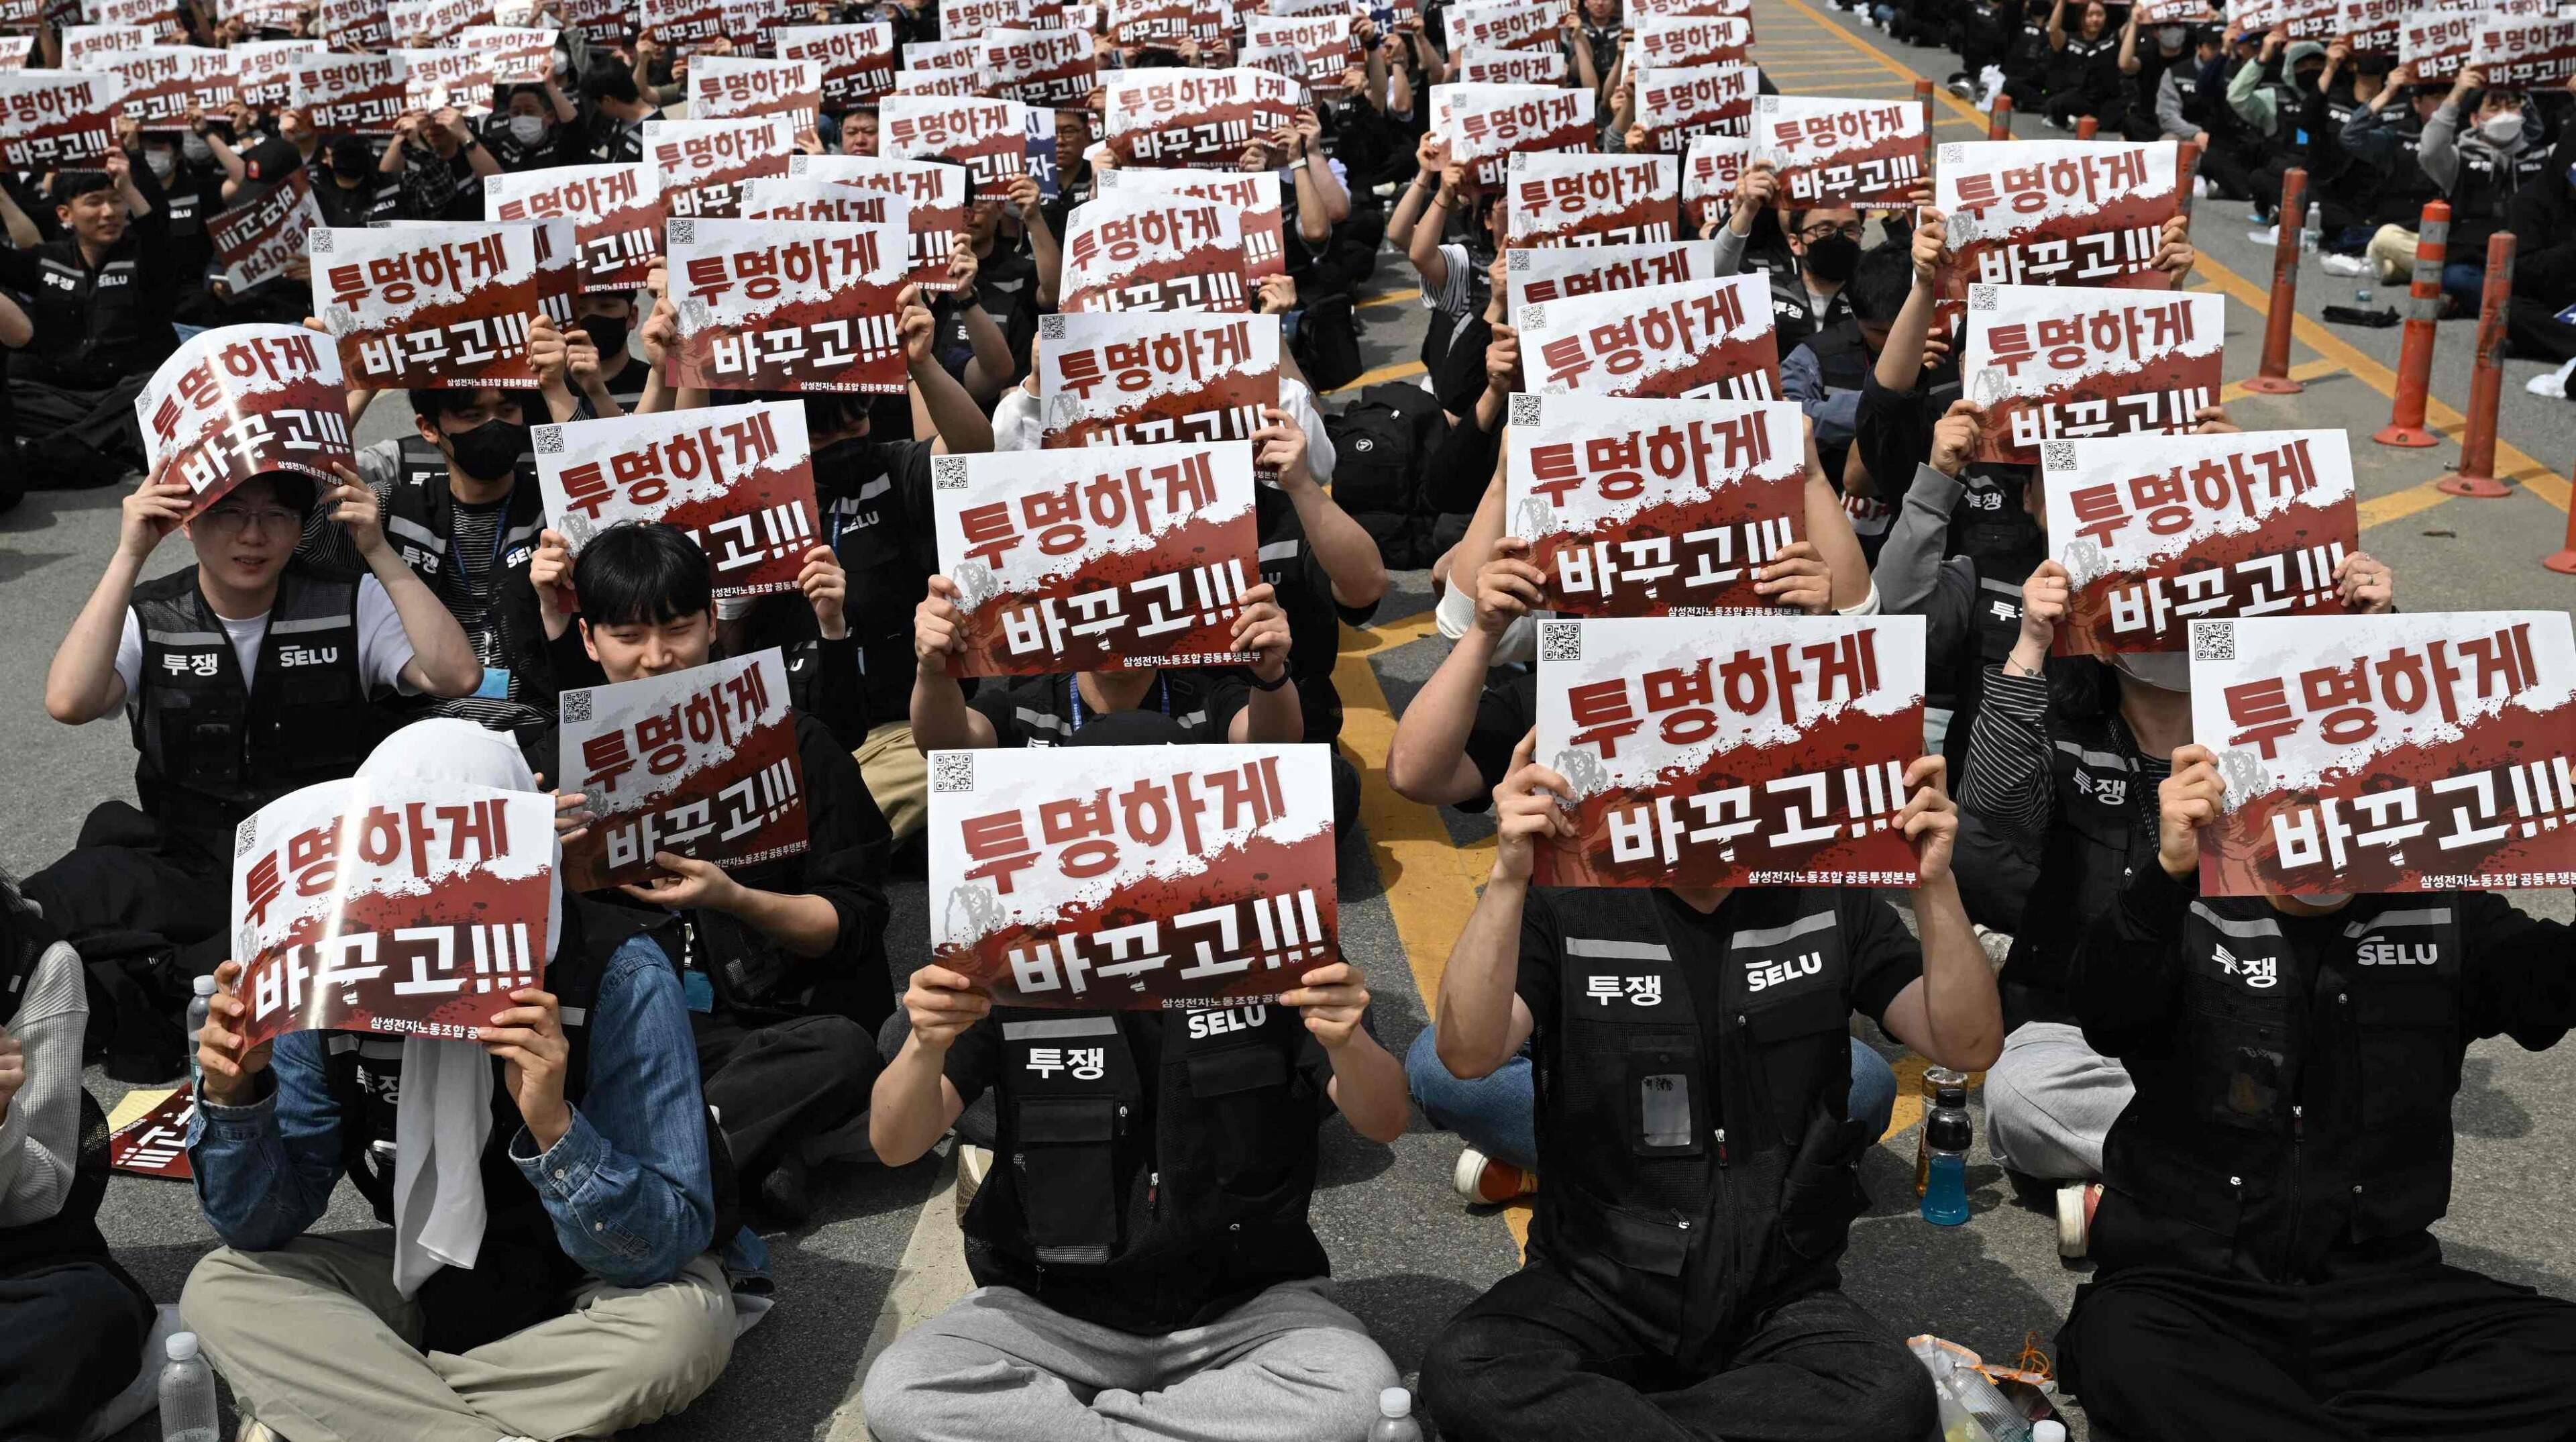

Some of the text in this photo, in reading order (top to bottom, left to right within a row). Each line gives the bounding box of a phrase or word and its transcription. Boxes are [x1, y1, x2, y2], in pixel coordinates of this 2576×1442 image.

[580, 22, 620, 40] 고!!!
[654, 18, 718, 41] 바꾸고!!!
[1119, 18, 1187, 42] 바꾸고!!!
[1474, 7, 1546, 44] 투명하게
[1644, 21, 1732, 57] 투명하게
[2409, 17, 2476, 48] 투명하
[2483, 21, 2574, 53] 투명하게
[988, 33, 1081, 72] 투명하게
[1308, 54, 1345, 80] 고!!!
[1469, 56, 1551, 83] 투명하게
[300, 60, 393, 93] 투명하게
[699, 64, 805, 105] 투명하게
[820, 67, 892, 103] 꾸고!!!
[1001, 73, 1093, 104] 바꾸고!!!
[1118, 75, 1236, 117] 투명하게
[1646, 71, 1744, 115] 투명하게
[123, 92, 186, 119] 꾸고!!!
[195, 86, 233, 108] 고!!!
[312, 97, 402, 127] 바꾸고!!!
[890, 105, 1008, 149] 투명하게
[1252, 110, 1289, 132] 고!!!
[1463, 94, 1578, 144] 투명하게
[1774, 106, 1904, 153] 투명하게
[4, 129, 110, 165] 바꾸고!!!
[655, 123, 775, 173] 투명하게
[1132, 119, 1248, 161] 바꾸고!!!
[965, 152, 1020, 185] 고!!!
[1695, 151, 1748, 183] 투명
[1790, 155, 1918, 200] 바꾸고!!!
[1956, 149, 2148, 220] 투명하게
[1519, 161, 1659, 217] 투명하게
[576, 227, 656, 274] 고!!!
[1071, 207, 1222, 270] 투명하게
[1978, 226, 2161, 285] 바꾸고!!!
[98, 275, 127, 287] SELU
[328, 232, 508, 312] 투명하게
[686, 230, 880, 306] 투명하게
[1083, 272, 1243, 312] 바꾸고!!!
[1773, 301, 1803, 319] 투쟁
[359, 312, 529, 377] 바꾸고!!!
[712, 313, 900, 380] 바꾸고!!!
[1542, 283, 1745, 389] 투명하게
[1988, 300, 2193, 376] 투명하게
[1058, 320, 1250, 399] 투명하게
[153, 334, 321, 442] 투명하게
[447, 378, 539, 387] 삼성전자노동조합 공동투쟁본부
[800, 382, 904, 393] 삼성전자노동조합 공동투쟁본부
[2010, 388, 2210, 446] 바꾸고!!!
[180, 409, 350, 495] 바꾸고!!!
[277, 460, 327, 479] 삼성전자노동조합
[559, 411, 780, 519] 투명하게
[1529, 409, 1772, 507] 투명하게
[959, 452, 1218, 569] 투명하게
[2070, 440, 2318, 548] 투명하게
[690, 501, 812, 572] 고!!!
[402, 545, 438, 575] 투쟁
[1557, 517, 1792, 599] 바꾸고!!!
[1002, 558, 1248, 660] 바꾸고!!!
[2108, 542, 2347, 639] 바꾸고!!!
[1668, 606, 1743, 617] 삼성전자노동조합
[1990, 601, 2021, 621] 투
[162, 654, 218, 676] 투쟁
[279, 646, 338, 668] SELU
[1123, 651, 1261, 667] 삼성전자노동조합 공동투쟁본부
[1567, 628, 1880, 759] 투명하게
[2222, 623, 2538, 760] 투명하게
[583, 661, 769, 793] 투명하게
[2072, 768, 2125, 805] 투쟁
[606, 757, 800, 870] 바꾸고!!!
[961, 756, 1287, 894] 투명하게
[1607, 760, 1907, 872] 바꾸고!!!
[2272, 756, 2576, 876] 바꾸고!!!
[246, 799, 510, 929] 투명하게
[711, 839, 808, 868] 성전자노동조합 공동투쟁본부
[1748, 870, 1917, 884] 삼성전자노동조합 공동투쟁본부
[2420, 870, 2576, 888] 삼성전자노동조합 공동투쟁본
[1008, 889, 1325, 995] 바꾸고!!!
[2357, 943, 2438, 966] SELU
[255, 924, 532, 1022] 바꾸고!!!
[1748, 951, 1823, 991] SELU
[2211, 943, 2277, 988] 투쟁
[1161, 996, 1258, 1008] 삼성전자노동조합
[1586, 975, 1662, 1006] 투쟁
[370, 1016, 465, 1037] 삼성전자노동조합
[1189, 1007, 1267, 1039] SELU
[1026, 1047, 1104, 1080] 투쟁
